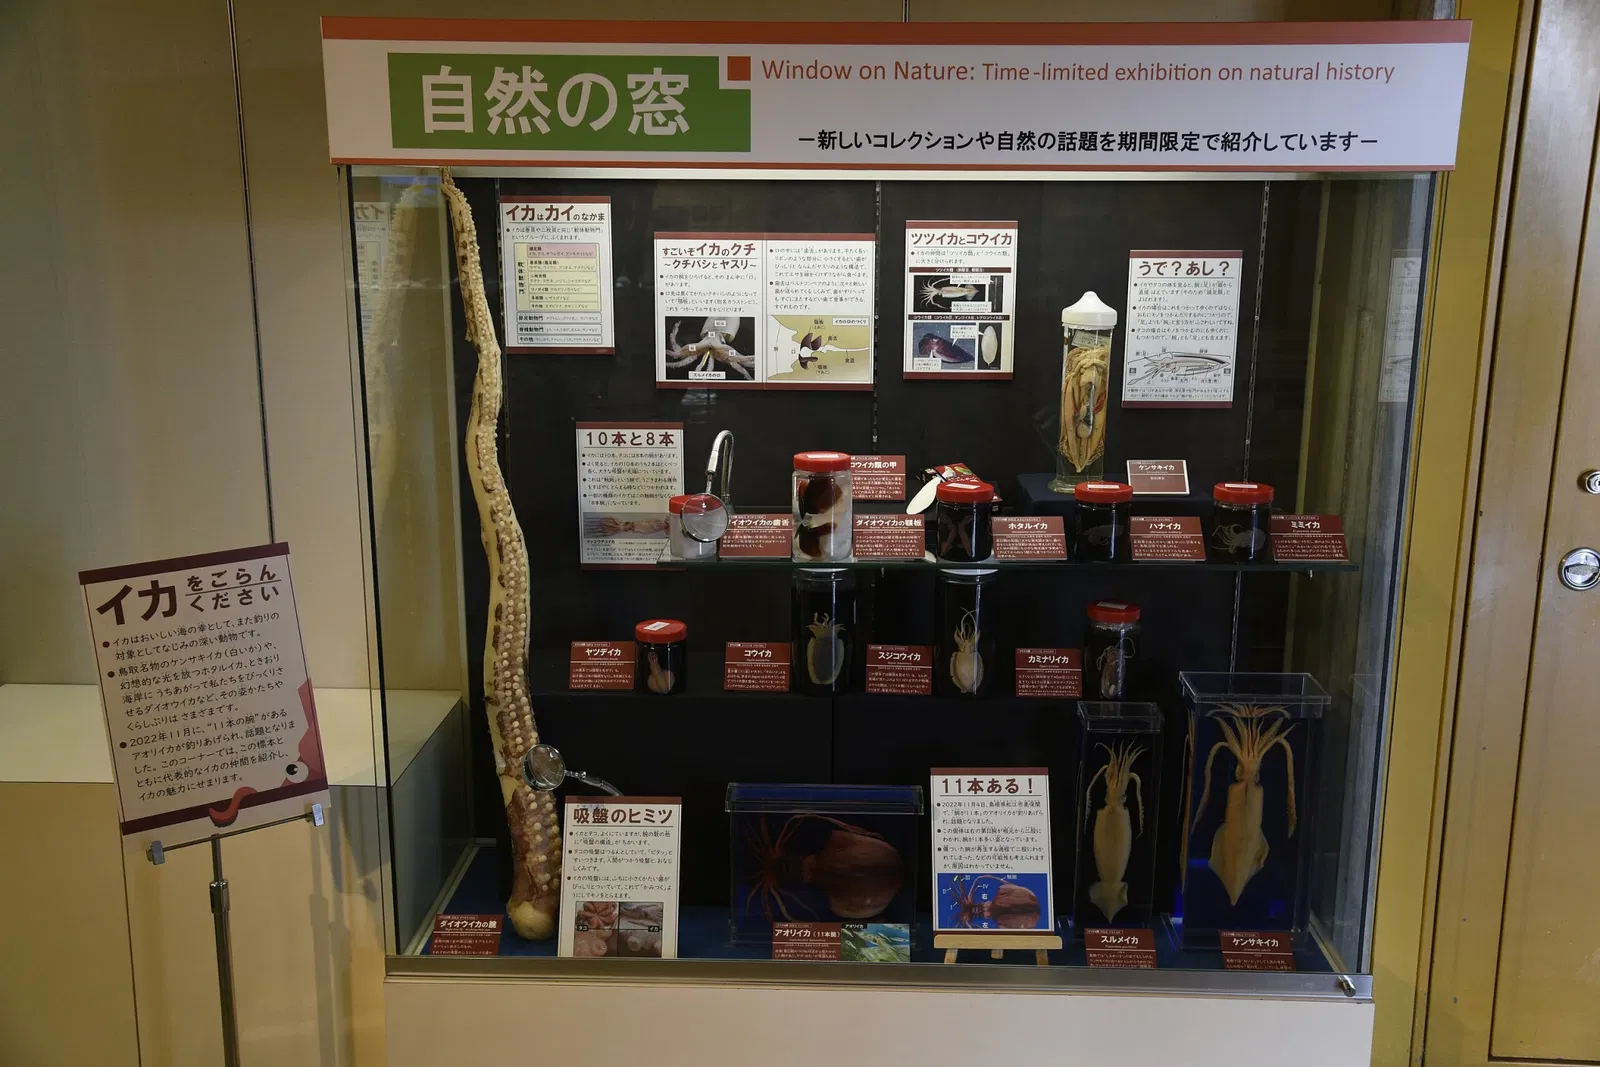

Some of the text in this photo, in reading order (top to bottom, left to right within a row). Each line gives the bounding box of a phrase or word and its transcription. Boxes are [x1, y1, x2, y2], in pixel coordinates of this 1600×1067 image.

[762, 60, 852, 81] Window
[859, 66, 885, 81] on
[895, 61, 974, 82] Nature:
[1115, 64, 1212, 82] exhibition
[1218, 68, 1242, 82] on
[1249, 63, 1320, 82] natural
[1326, 62, 1396, 85] history
[422, 65, 690, 137] 自然の窓
[506, 204, 605, 222] イカはカイのなかま
[911, 232, 1012, 246] ツツイカとコウイカ
[662, 243, 756, 257] すごいぞイカのクチ
[1139, 261, 1229, 276] うで？あし？
[586, 431, 675, 447] 10本と8本
[1008, 522, 1048, 530] ホタルイカ
[1291, 521, 1321, 529] ミミイカ
[95, 579, 178, 627] イカ
[190, 586, 279, 613] ください
[112, 614, 280, 647] イカはおいしい海の幸として、また釣りの
[115, 630, 263, 661] 対象としてなじみの深い動物です。
[585, 648, 622, 657] ヤツデイカ
[744, 650, 772, 658] コウイカ
[878, 651, 921, 661] スジコウイカ
[1028, 655, 1069, 664] カミナリイカ
[120, 654, 281, 690] 幻想的な光を放つホタルイカ、ときおり
[125, 682, 285, 717] せるダイオウイカなど、その姿かたちや
[132, 722, 296, 760] アオリイカが釣りあげられ、話題となりま
[134, 737, 285, 774] した。このコーナーでは、この標本と
[136, 752, 290, 788] ともに代表的なイカの仲間を紹介し、
[138, 776, 245, 802] イカの魅力にせまります。
[573, 808, 673, 824] 吸盤のヒミツ
[1100, 935, 1139, 945] スルメイカ
[1232, 937, 1279, 948] ケンサキイカ
